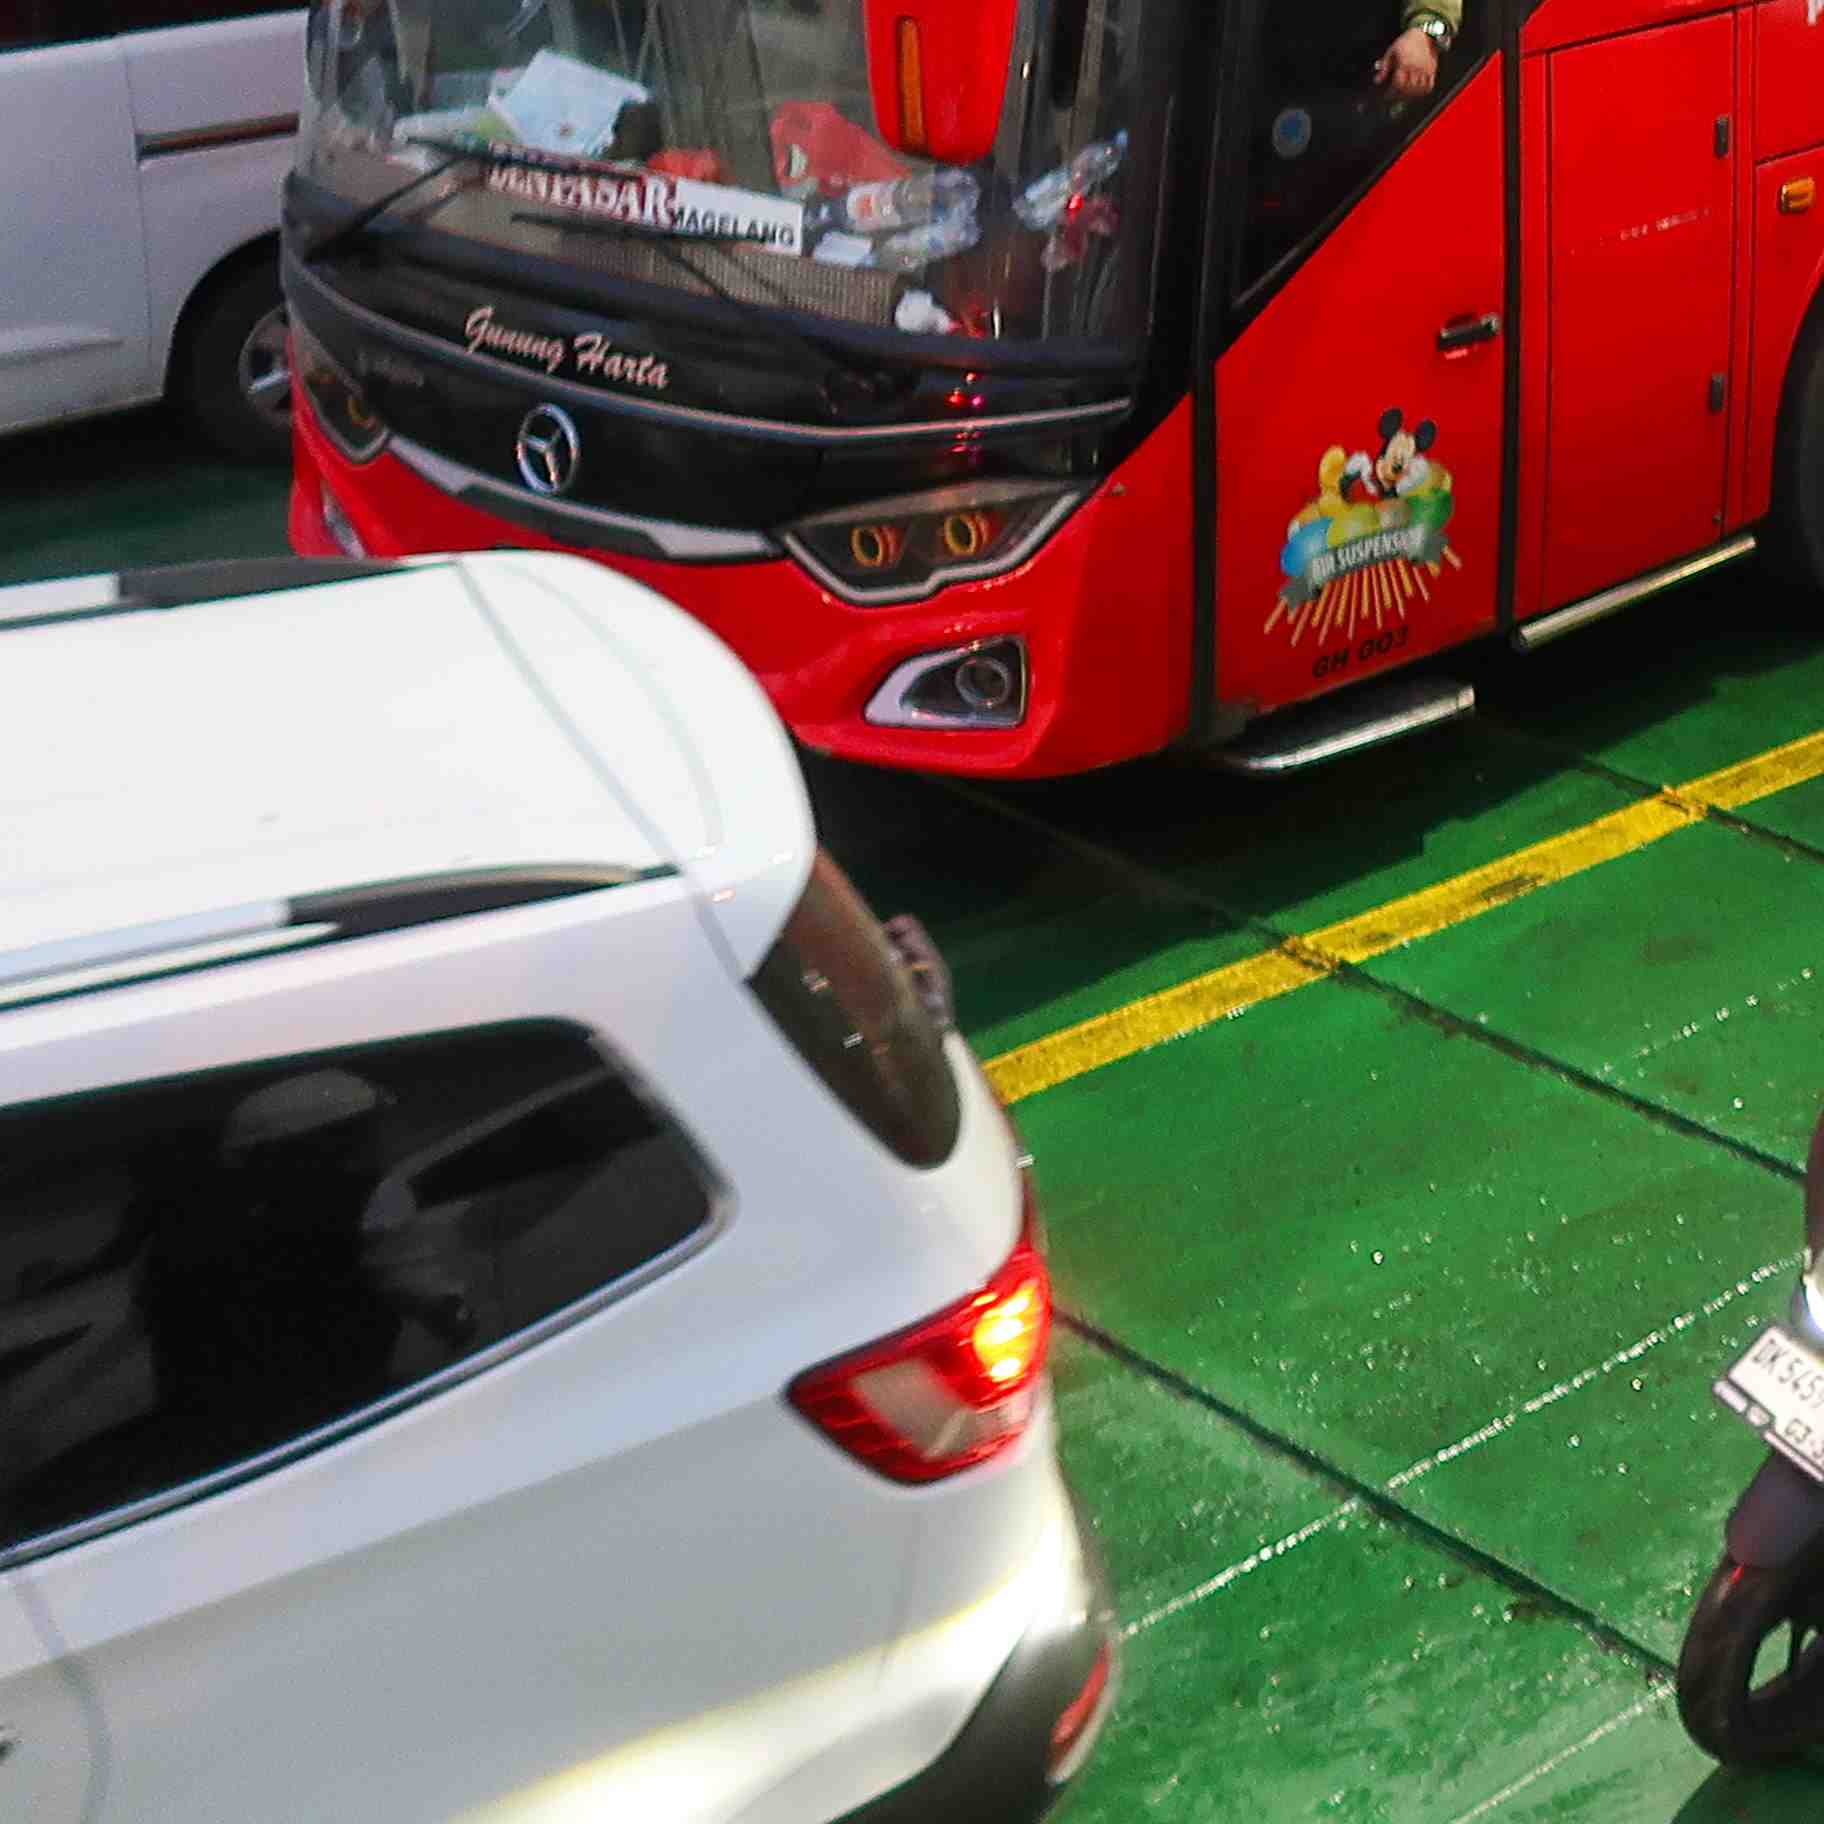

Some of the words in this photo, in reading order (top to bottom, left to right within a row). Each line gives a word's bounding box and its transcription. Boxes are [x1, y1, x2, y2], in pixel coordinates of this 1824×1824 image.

[464, 304, 564, 375] Gunung
[573, 330, 671, 391] Harta
[1752, 1338, 1789, 1374] DK
